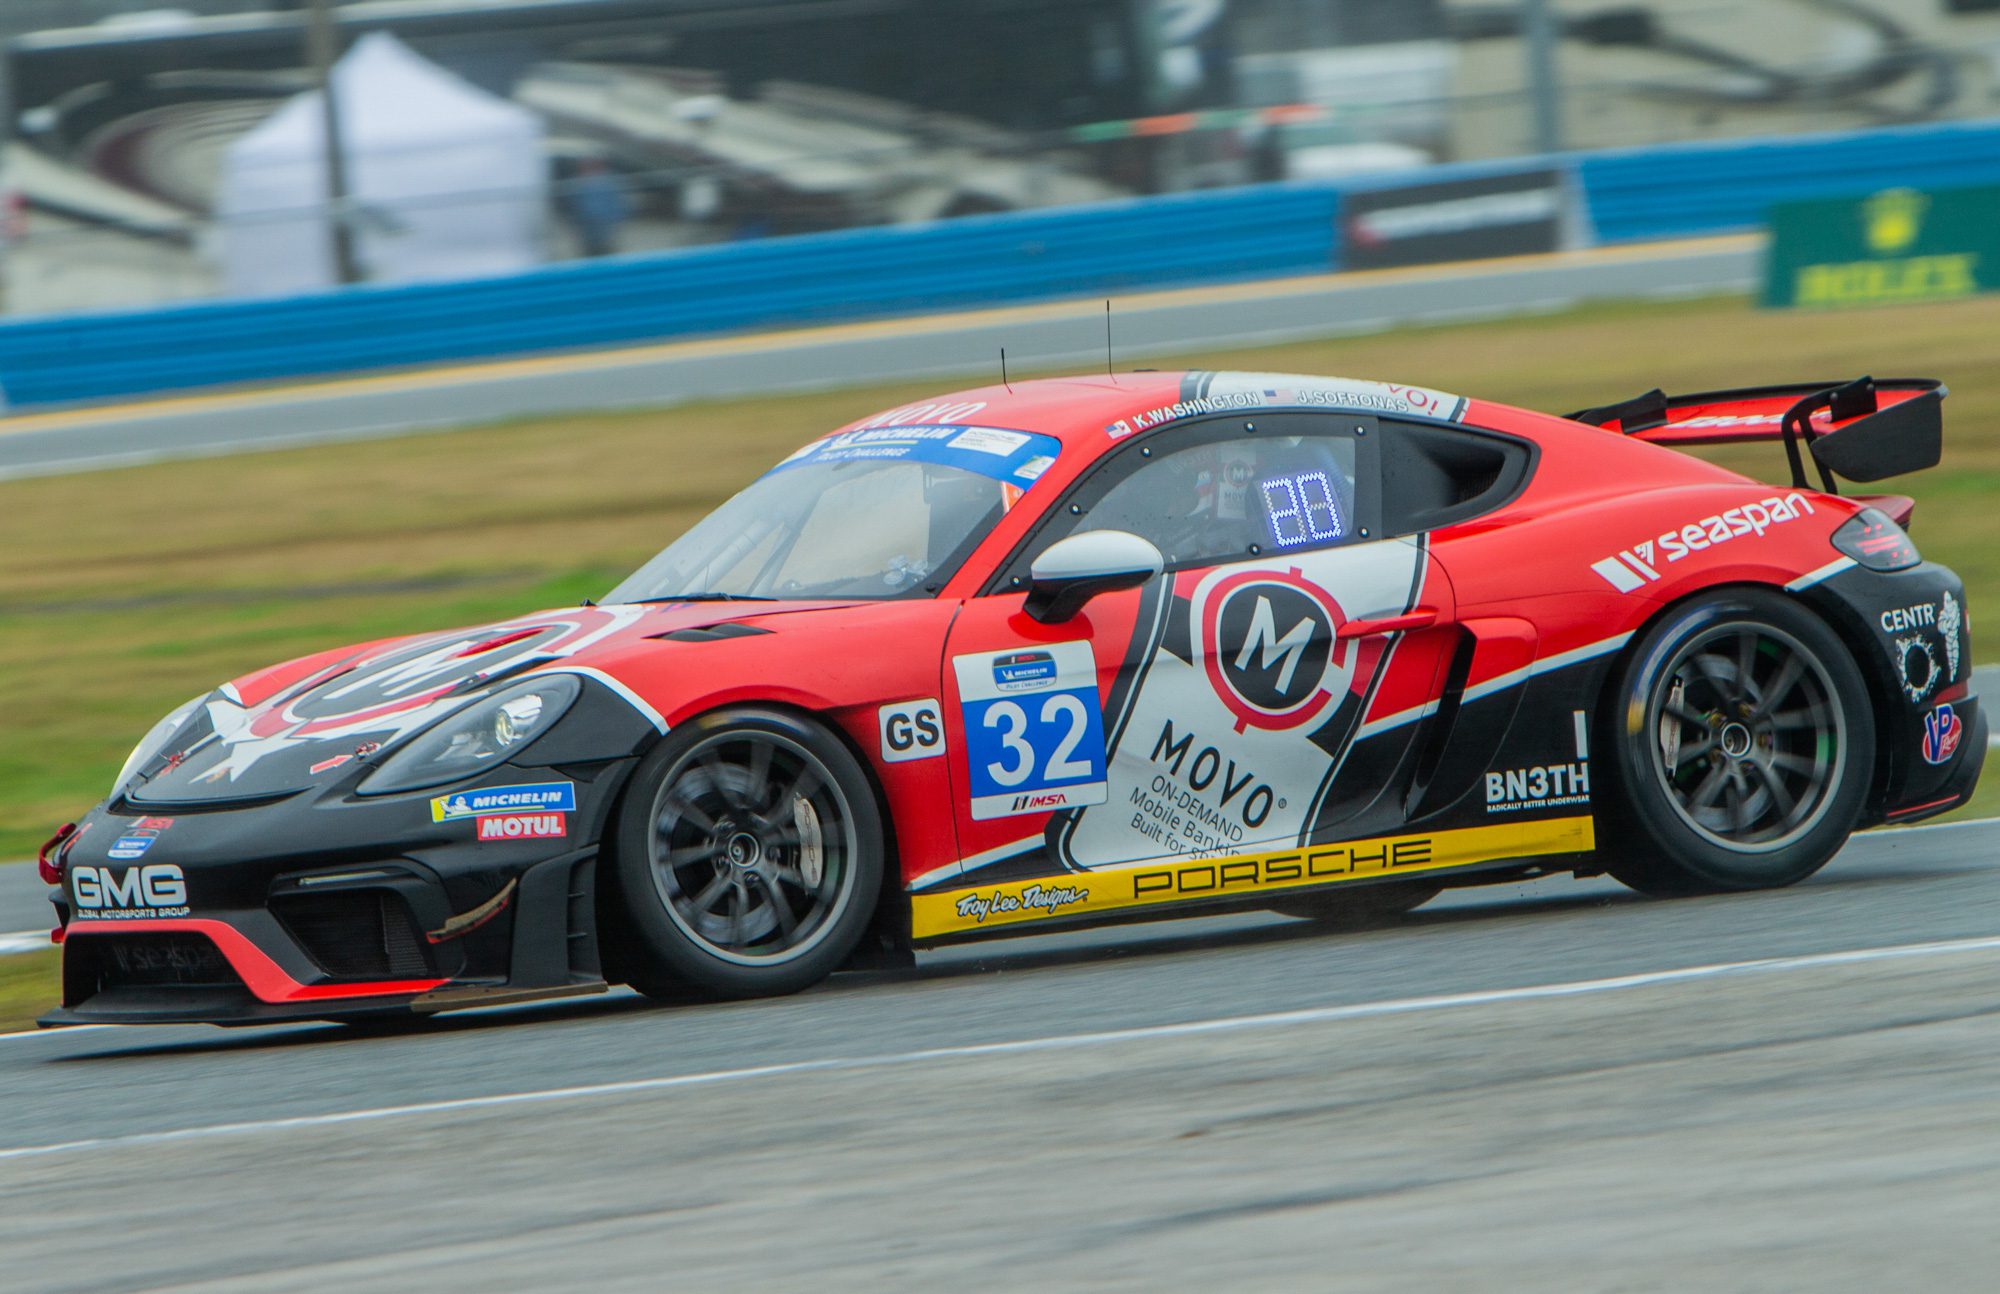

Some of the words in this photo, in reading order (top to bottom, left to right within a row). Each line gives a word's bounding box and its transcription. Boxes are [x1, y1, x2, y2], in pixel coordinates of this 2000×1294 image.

[1132, 391, 1261, 429] K.WASHINGTON
[1298, 390, 1409, 412] J.SOFRONAS
[1262, 471, 1342, 547] 20
[1658, 492, 1815, 563] seaspan
[1234, 595, 1316, 696] M
[886, 709, 940, 751] GS
[983, 694, 1092, 787] 32
[1925, 703, 1953, 762] VP
[1150, 718, 1274, 828] MOVO
[1486, 762, 1589, 803] BN3TH
[473, 791, 562, 808] MICHELIN
[1130, 787, 1180, 830] Mobile
[1151, 775, 1243, 842] ON-DEMAND
[1487, 802, 1521, 813] RADICALLY
[1523, 799, 1546, 809] BETTER
[1547, 795, 1590, 806] UNDERWEAR
[481, 815, 562, 837] MOTUL
[1131, 813, 1163, 843] Built
[1164, 832, 1187, 855] for
[72, 864, 188, 908] GMG
[1133, 839, 1432, 898] PORSCHE
[78, 909, 99, 919] GLOBAL
[101, 908, 157, 919] MOTORSPORTS
[158, 907, 190, 918] GROUP
[957, 893, 991, 922] Troy
[990, 890, 1021, 913] Lee
[1021, 884, 1089, 914] Designs
